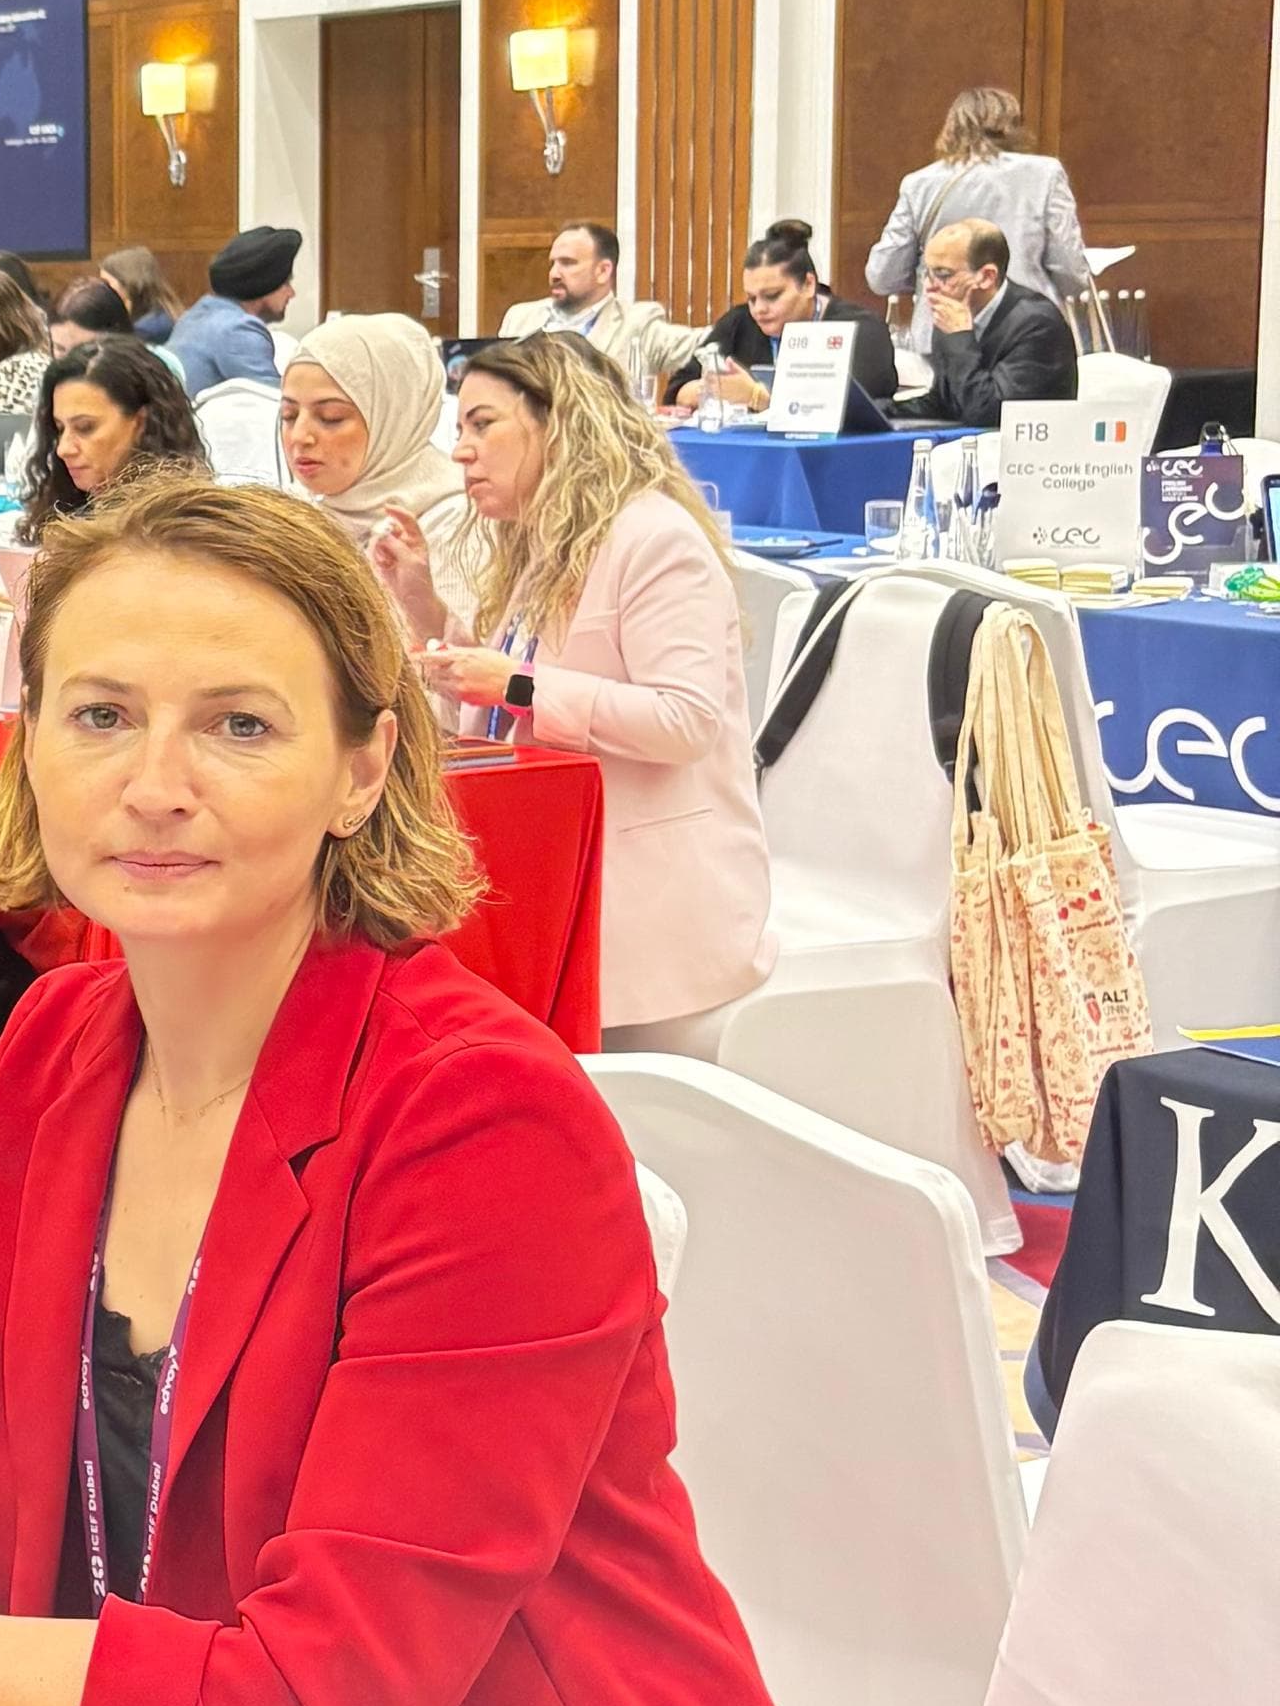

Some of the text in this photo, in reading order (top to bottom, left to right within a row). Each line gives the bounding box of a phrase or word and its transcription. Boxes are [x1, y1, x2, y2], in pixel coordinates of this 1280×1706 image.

[1015, 422, 1049, 442] F18
[1006, 463, 1034, 476] CEC
[1049, 463, 1081, 476] Cork
[1084, 462, 1133, 478] English
[1042, 476, 1096, 492] College
[1141, 1096, 1280, 1326] K
[80, 1352, 91, 1411] edvoy
[159, 1357, 180, 1415] edvoy
[150, 1461, 162, 1515] Dubai
[84, 1460, 107, 1597] 20 ICEF Dubai
